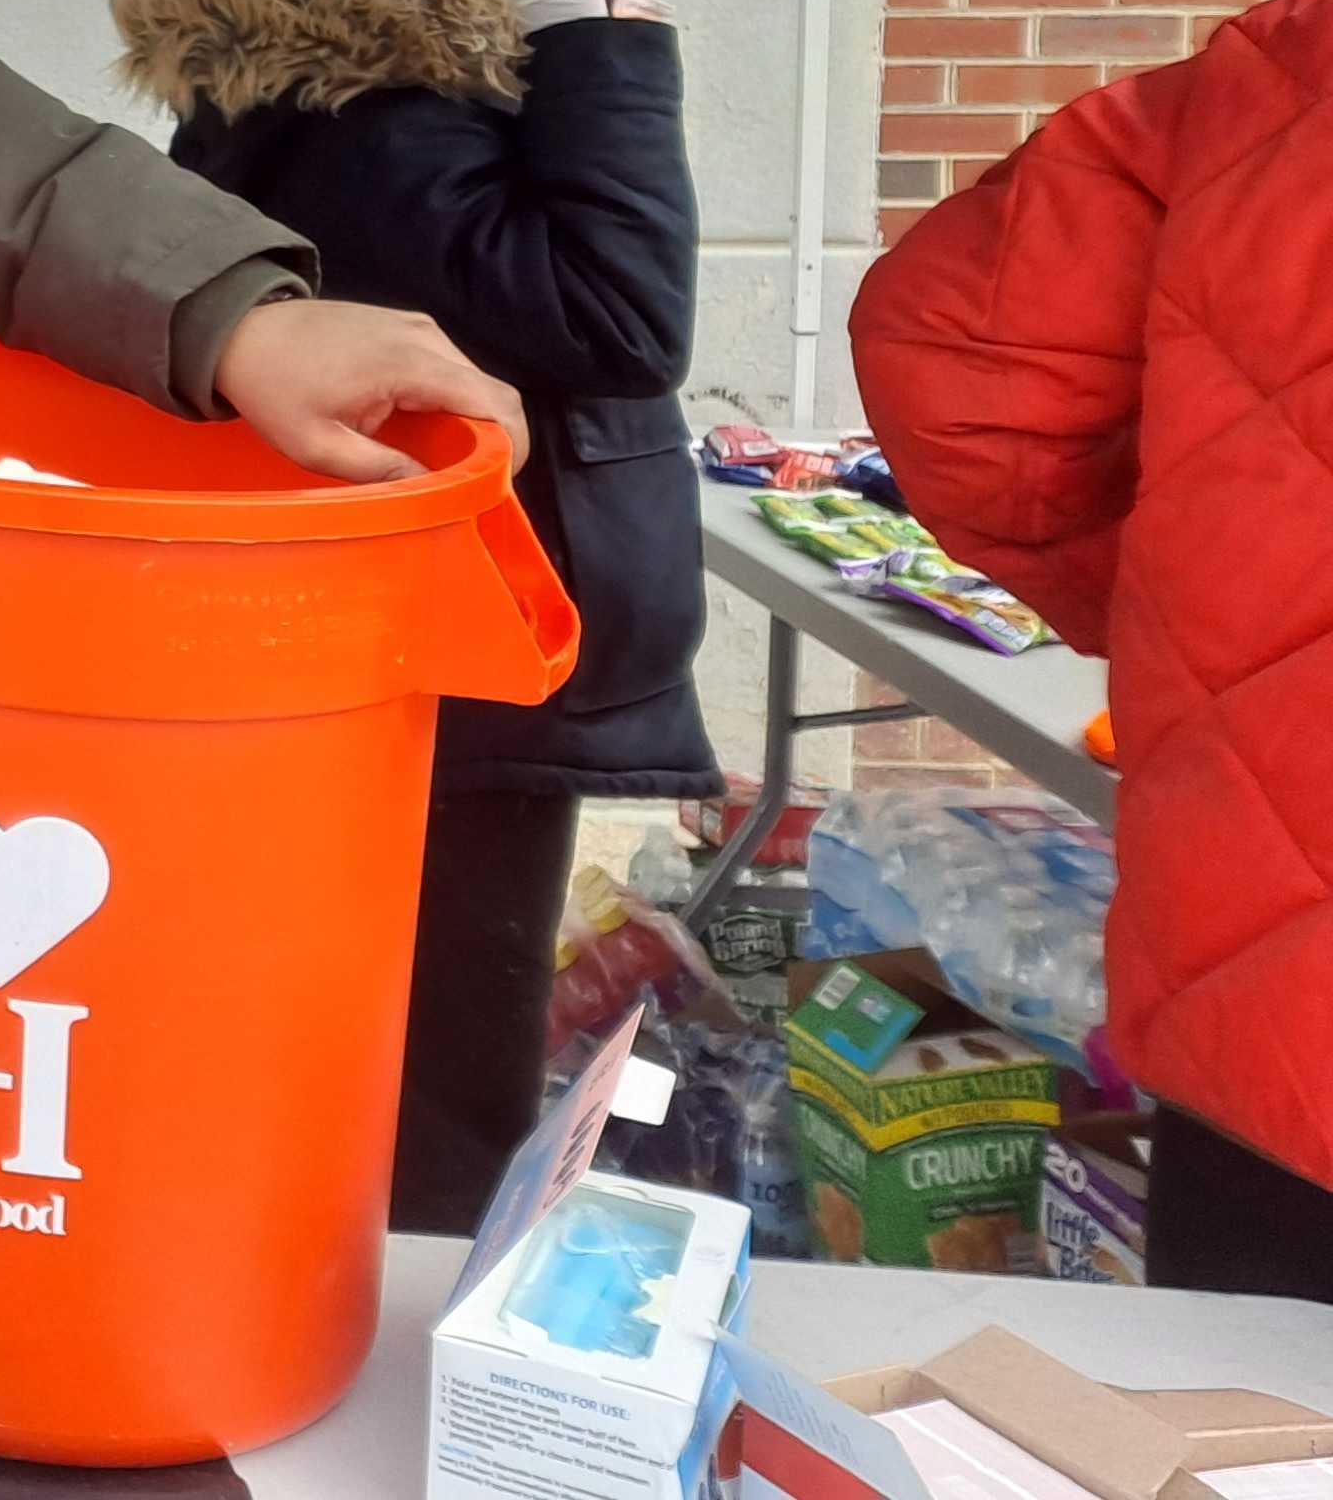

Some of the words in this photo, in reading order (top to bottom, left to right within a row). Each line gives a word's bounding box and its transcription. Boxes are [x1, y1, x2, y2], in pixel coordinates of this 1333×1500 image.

[908, 1138, 1034, 1191] CRUNCHY
[1044, 1143, 1087, 1194] 20
[489, 1372, 567, 1403] DIRECTIONS
[571, 1395, 598, 1414] FOR
